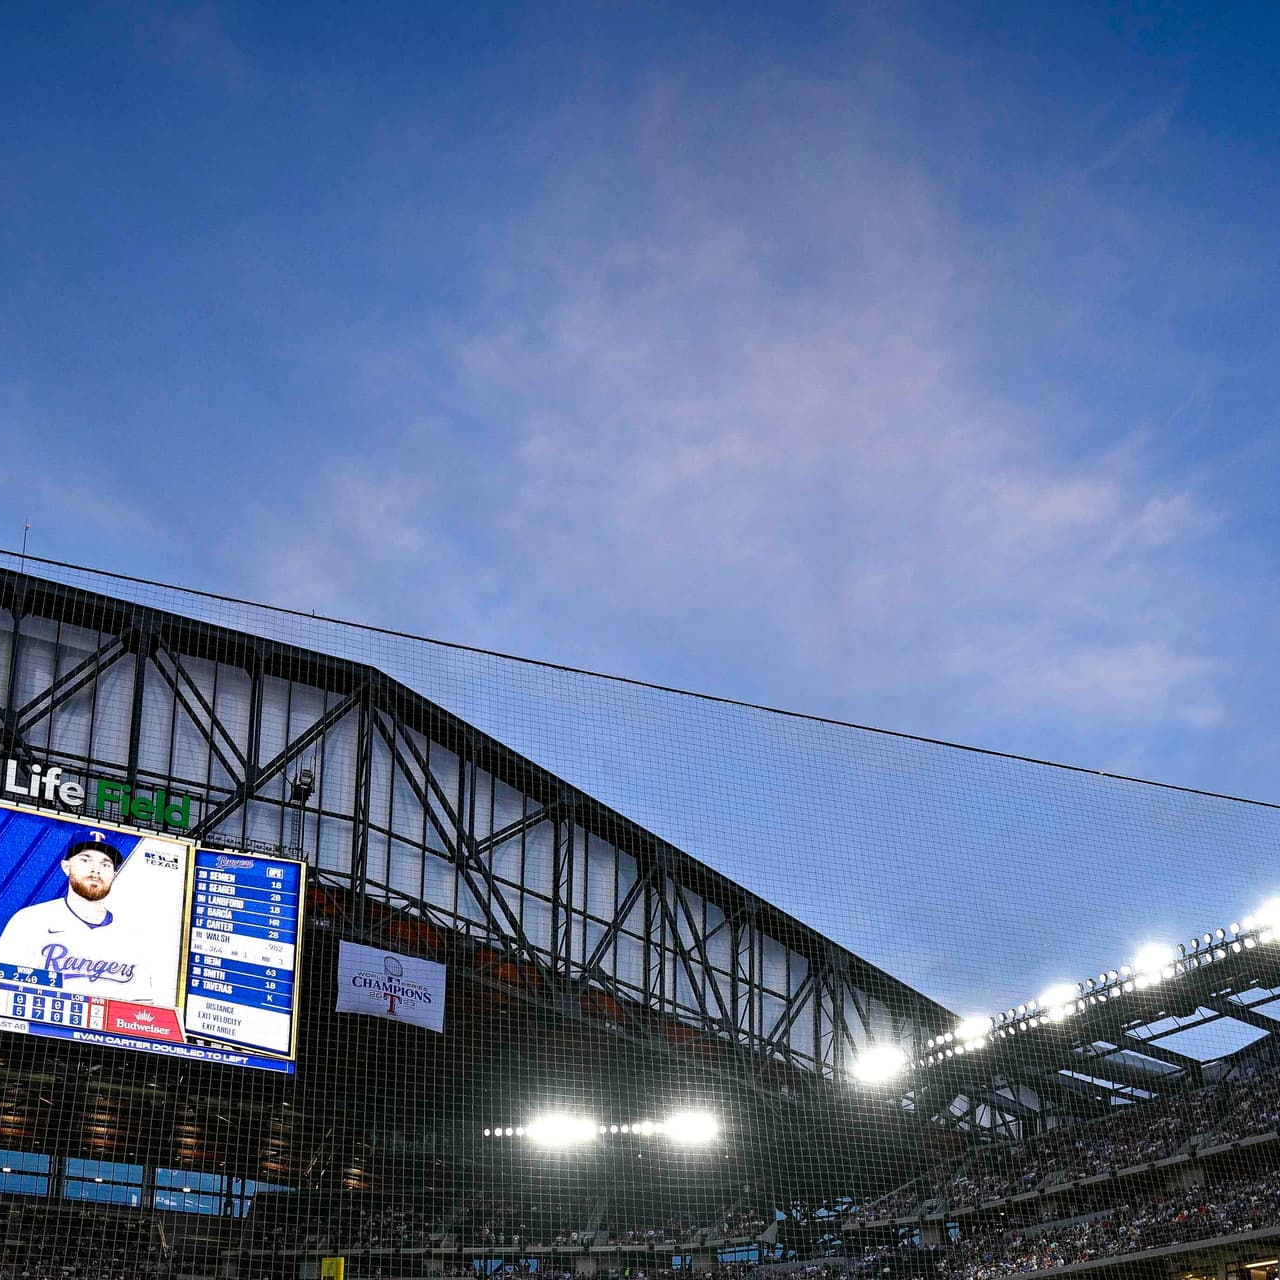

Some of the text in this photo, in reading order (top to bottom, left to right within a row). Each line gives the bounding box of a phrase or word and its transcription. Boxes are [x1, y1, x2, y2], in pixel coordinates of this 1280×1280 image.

[5, 757, 84, 807] Life
[96, 780, 191, 830] Field
[145, 859, 179, 870] TEXAS
[41, 943, 136, 983] Rangers
[13, 972, 38, 984] 2.40
[357, 971, 387, 981] WORLD
[351, 975, 432, 1004] CHAMPIONS
[205, 1002, 235, 1014] DISTANCE
[13, 1022, 27, 1031] AB
[198, 1012, 242, 1027] EXIT VELOCITY
[116, 1018, 170, 1036] Budweiser
[202, 1022, 236, 1036] EXIT ANGLE
[73, 1031, 249, 1065] EVAN CARTER DOUBLED TO LEFT
